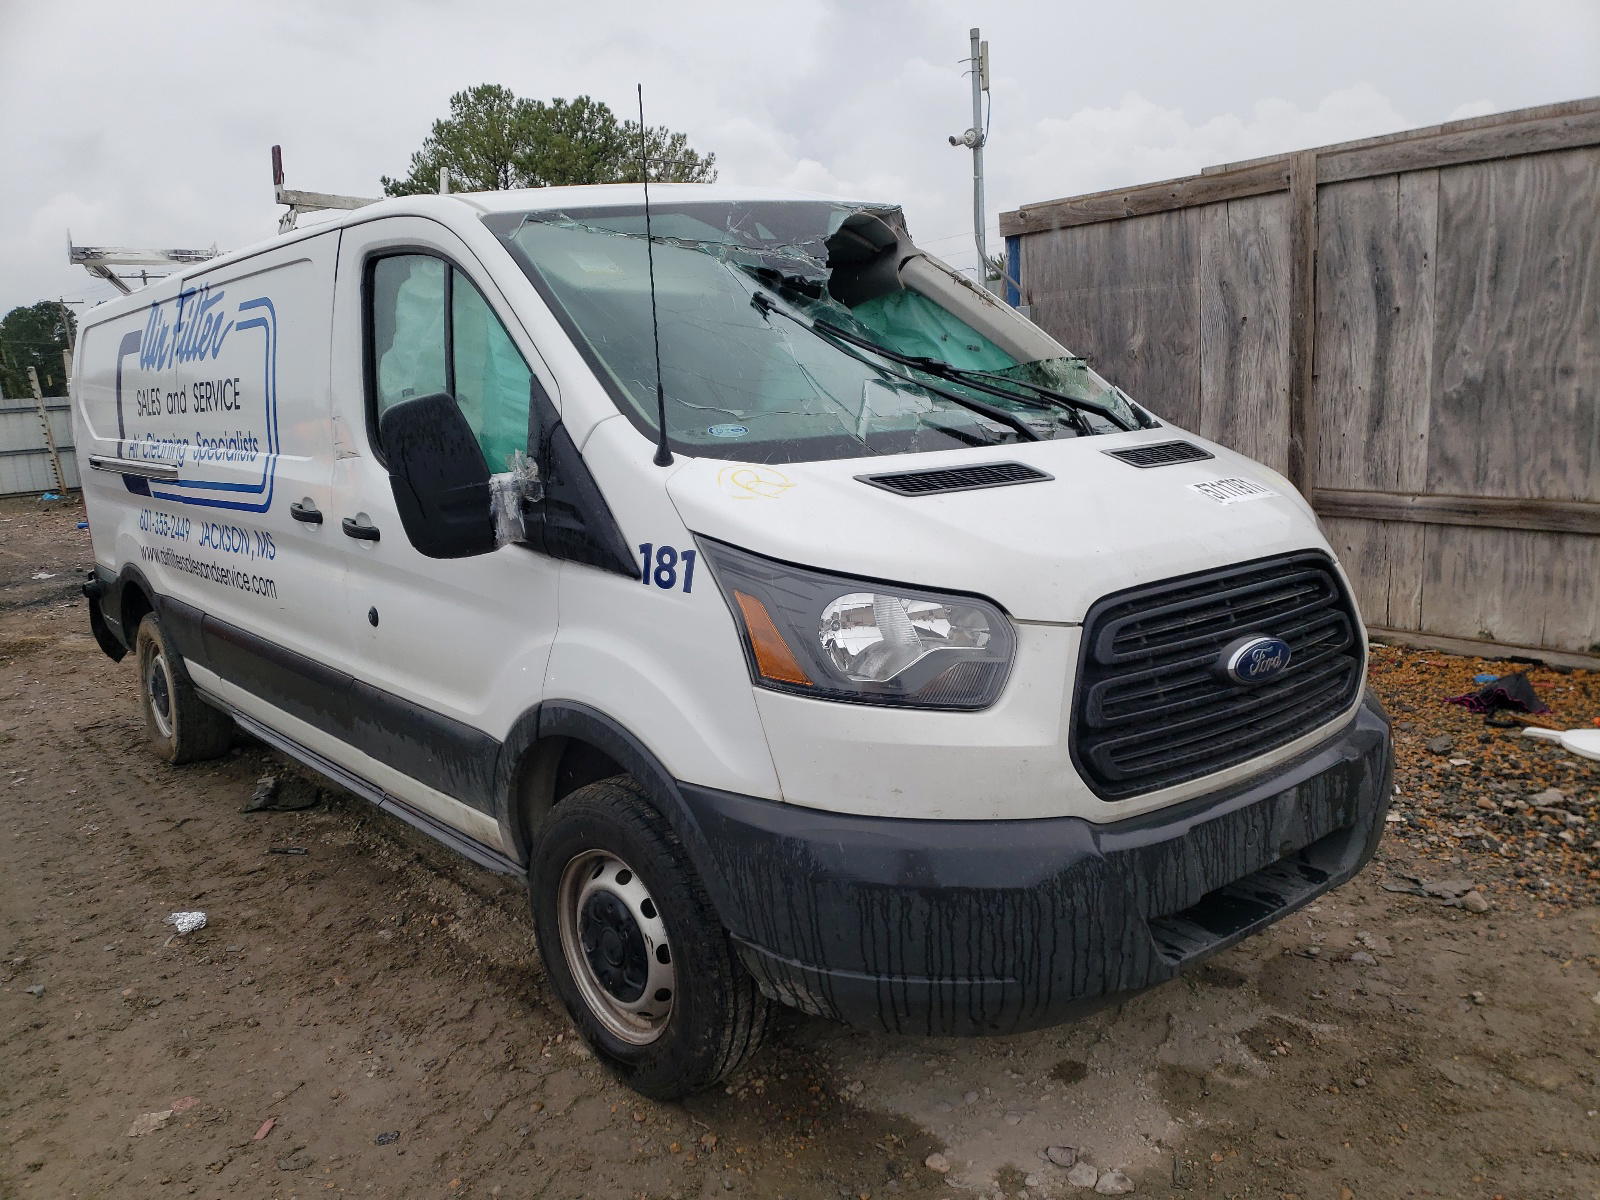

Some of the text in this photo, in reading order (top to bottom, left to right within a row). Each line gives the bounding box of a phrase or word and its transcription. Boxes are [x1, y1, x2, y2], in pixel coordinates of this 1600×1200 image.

[136, 377, 242, 417] SALES and SERVICE
[128, 430, 259, 468] Air Cleaning Specialists
[254, 530, 276, 561] MS
[639, 542, 697, 593] 181
[1249, 645, 1282, 676] Ford
